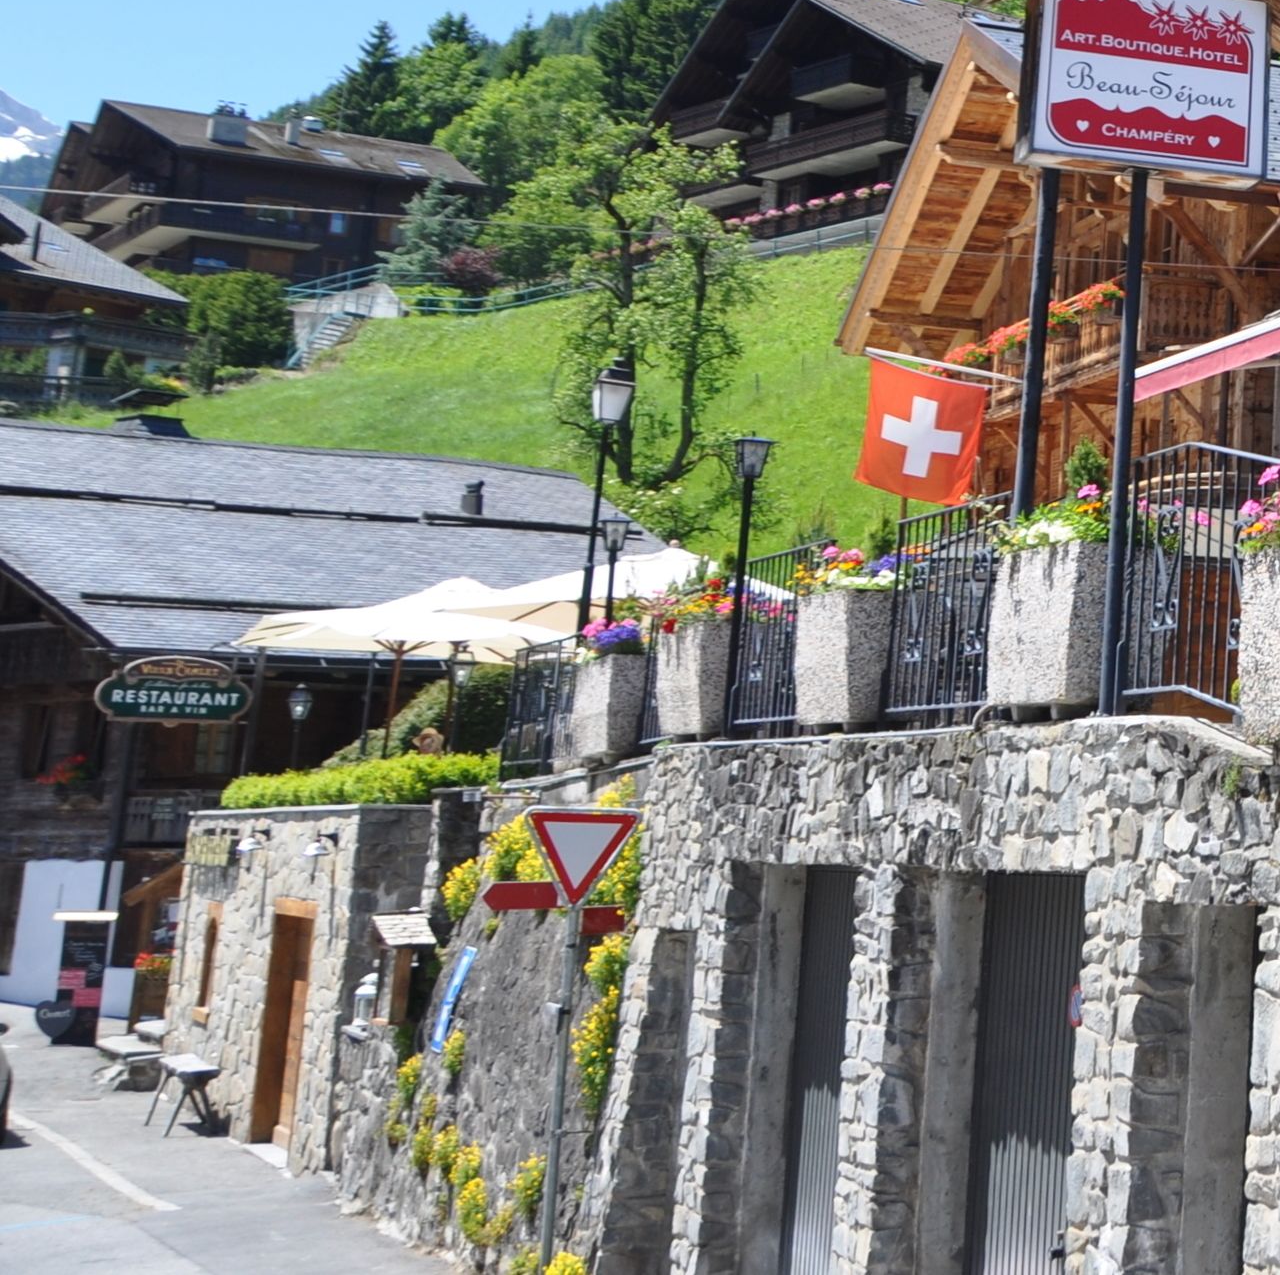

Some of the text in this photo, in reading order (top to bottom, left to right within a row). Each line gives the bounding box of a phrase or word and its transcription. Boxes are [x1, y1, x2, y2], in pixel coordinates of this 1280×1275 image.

[1065, 61, 1237, 111] Beau-Séjour
[1101, 122, 1196, 146] CHAMPÉRY
[111, 689, 241, 707] RESTAURANT
[139, 705, 165, 714] BAR
[184, 706, 208, 715] VIN
